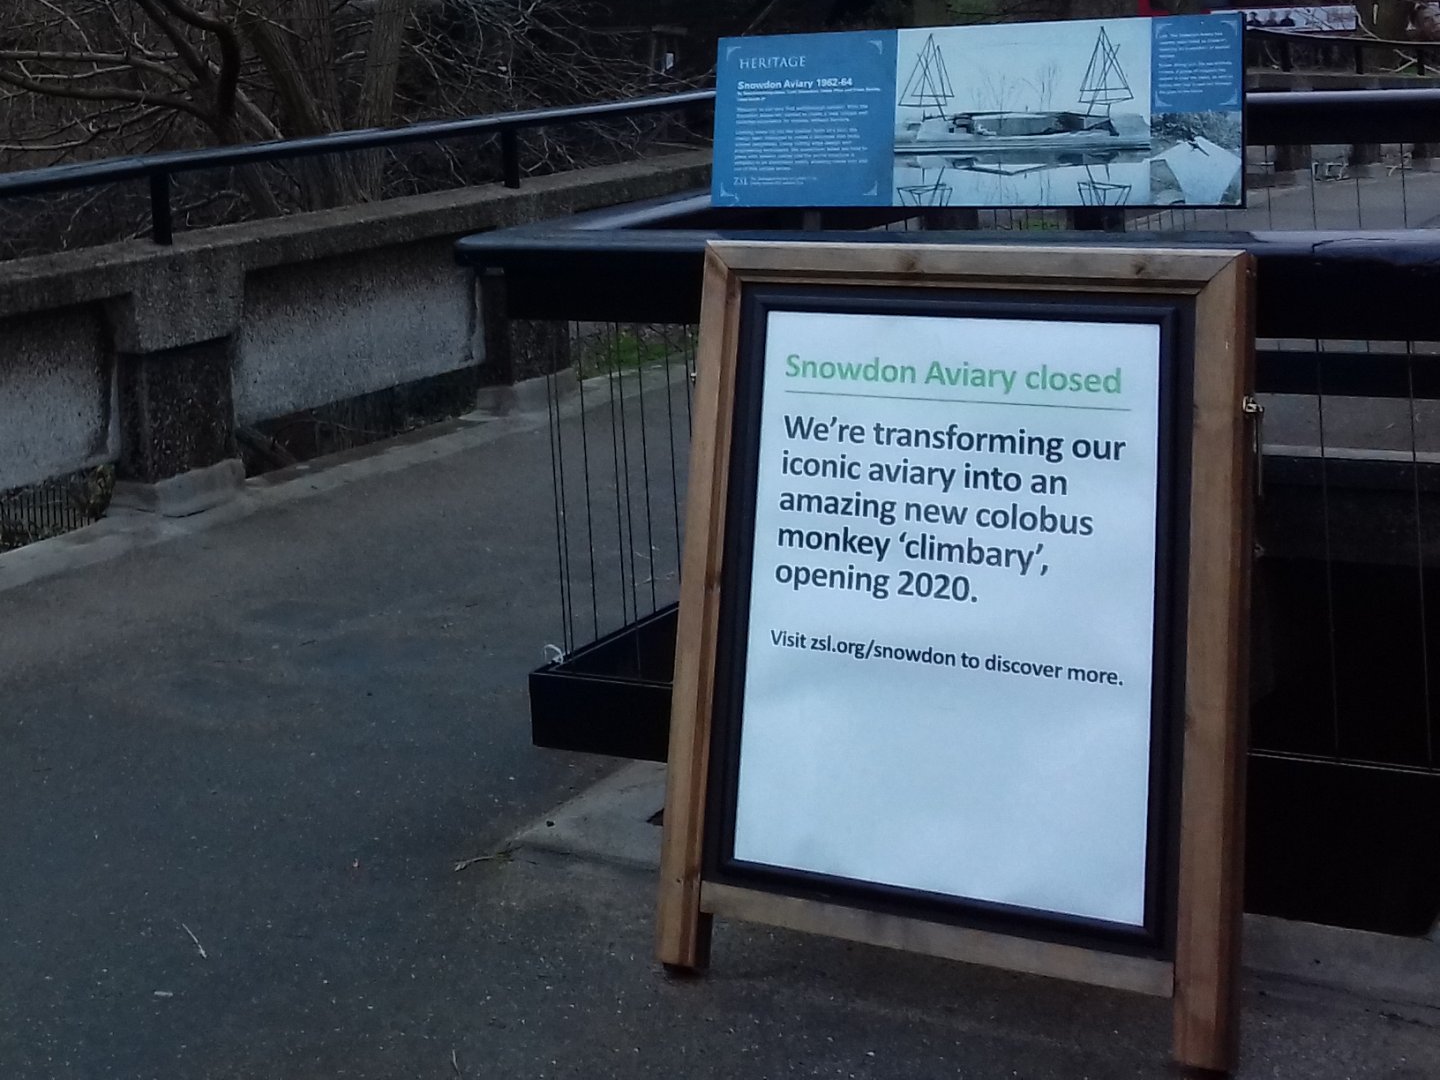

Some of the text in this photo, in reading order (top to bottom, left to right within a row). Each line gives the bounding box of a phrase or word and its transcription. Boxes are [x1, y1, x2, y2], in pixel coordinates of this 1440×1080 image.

[739, 56, 806, 69] HERITAGE
[737, 77, 853, 90] Snowdon Aviary 1962-64
[785, 354, 1122, 395] Snowdon Aviary closed
[783, 414, 1128, 464] We’re transforming our
[782, 451, 1068, 496] iconic aviary into an
[778, 492, 1094, 537] amazing new colobus
[777, 527, 891, 563] monkey
[774, 564, 979, 604] opening 2020.
[770, 629, 1125, 688] Visit zsl.org/snowdon to discover more.
